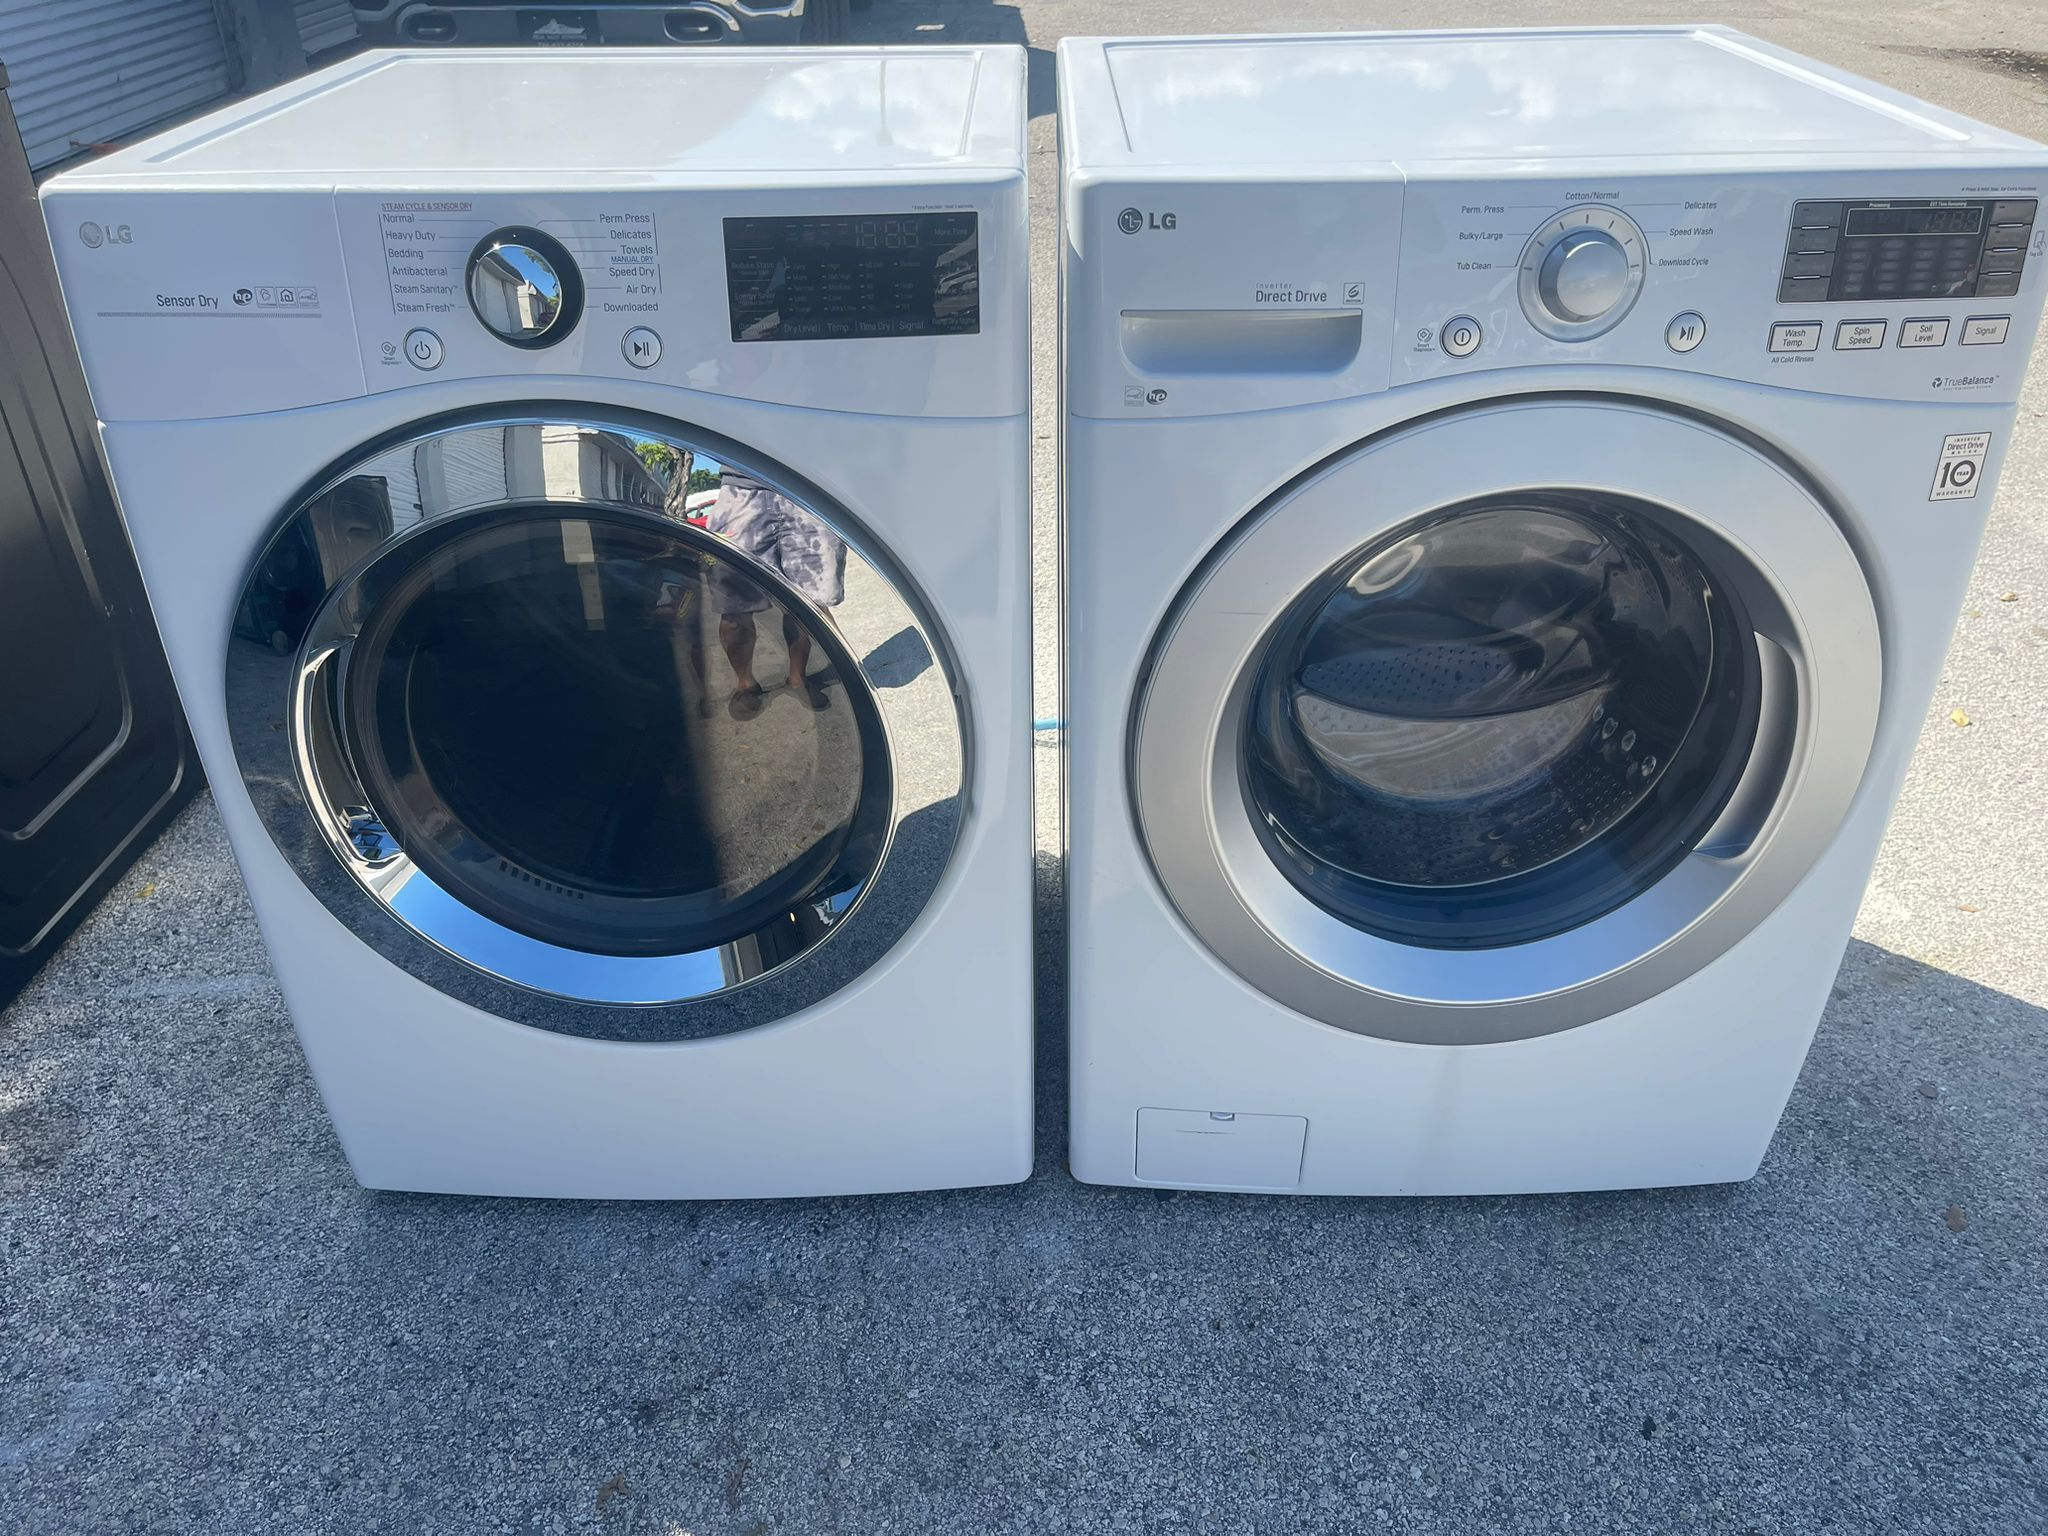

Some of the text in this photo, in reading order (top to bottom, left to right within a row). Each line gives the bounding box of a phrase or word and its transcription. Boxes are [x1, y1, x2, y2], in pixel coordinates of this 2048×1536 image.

[1565, 191, 1620, 201] Cotton/Normal
[382, 202, 405, 211] STEAM
[405, 202, 425, 210] CYCLE
[433, 202, 459, 210] SENSOR
[460, 202, 473, 210] DRY
[1461, 205, 1505, 214] Perm. Press
[1684, 201, 1718, 209] Delicates
[383, 213, 415, 223] Normal
[625, 213, 650, 223] Press
[1148, 212, 1177, 231] LG
[106, 224, 134, 244] LG
[385, 230, 436, 241] Heavy Duty
[610, 229, 652, 239] Delicates
[1459, 231, 1504, 241] Bulky/Large
[1669, 226, 1714, 237] Speed Wash
[388, 248, 424, 260] Bedding
[620, 244, 654, 254] Towels
[611, 255, 654, 263] MANUAL DRY
[1658, 257, 1709, 267] Download Cycle
[1456, 262, 1492, 270] Tub Clean
[392, 266, 448, 277] Antibacterial
[609, 266, 655, 278] Speed Dry
[394, 284, 419, 294] Steam
[626, 284, 657, 295] Air Dry
[1256, 290, 1327, 302] Direct Drive
[156, 294, 219, 310] Sensor Dry
[397, 302, 424, 312] Steam
[603, 302, 659, 312] Downloaded
[1785, 328, 1806, 338] Wash
[1853, 327, 1871, 337] Spin
[1920, 324, 1933, 333] Soil
[1975, 327, 1997, 337] Signal
[1848, 336, 1872, 346] Speed
[1914, 334, 1934, 342] Level
[1771, 354, 1814, 364] All Cold Rinses
[1947, 442, 1984, 451] Direct Drive
[1940, 460, 1976, 488] 10
[1936, 489, 1972, 497] WARRANTY
